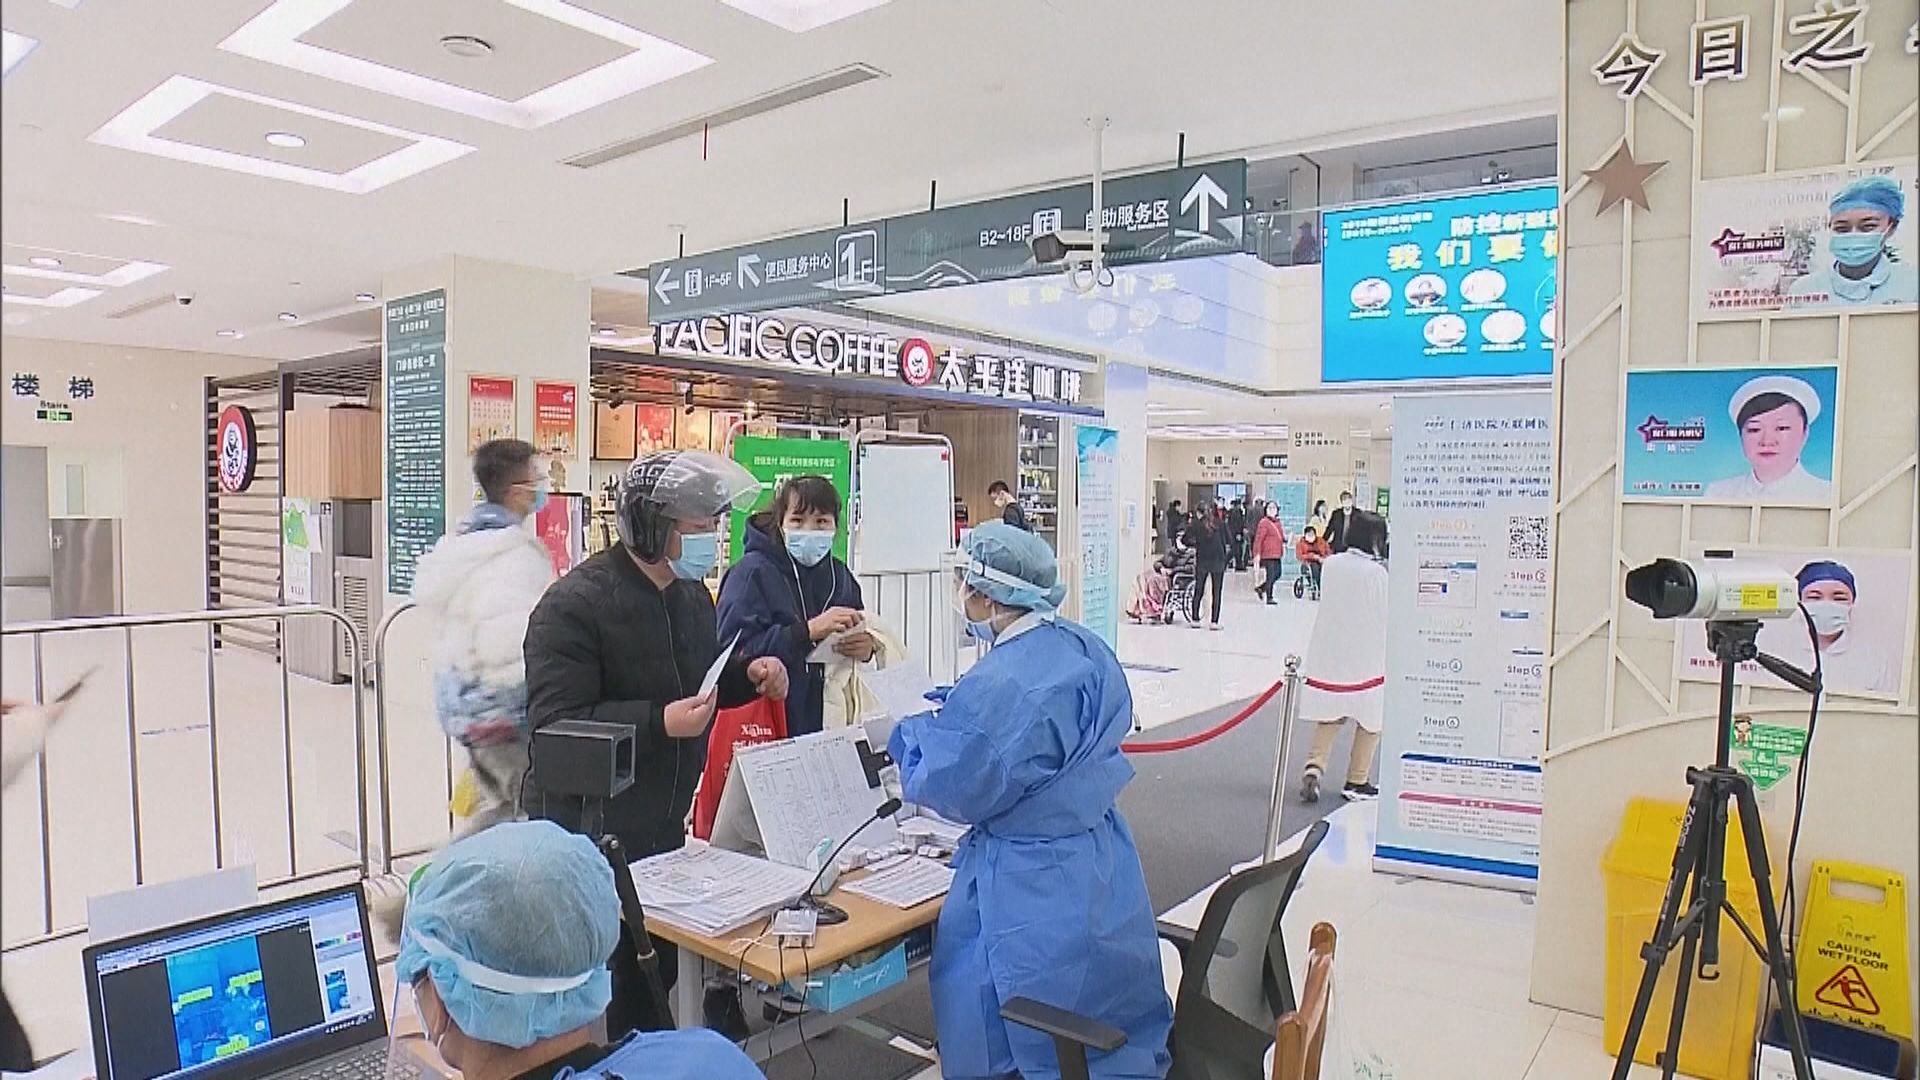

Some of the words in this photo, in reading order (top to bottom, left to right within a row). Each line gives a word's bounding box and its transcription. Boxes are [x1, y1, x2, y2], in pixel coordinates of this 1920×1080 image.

[1593, 4, 1918, 97] 今日之
[789, 325, 898, 377] COFFEE
[11, 372, 95, 399] 楼梯
[939, 347, 1081, 403] 太平洋咖啡
[40, 400, 69, 410] Stairs
[1818, 947, 1844, 960] WET
[1846, 954, 1889, 971] FLOOR
[1827, 940, 1881, 959] CAUTION
